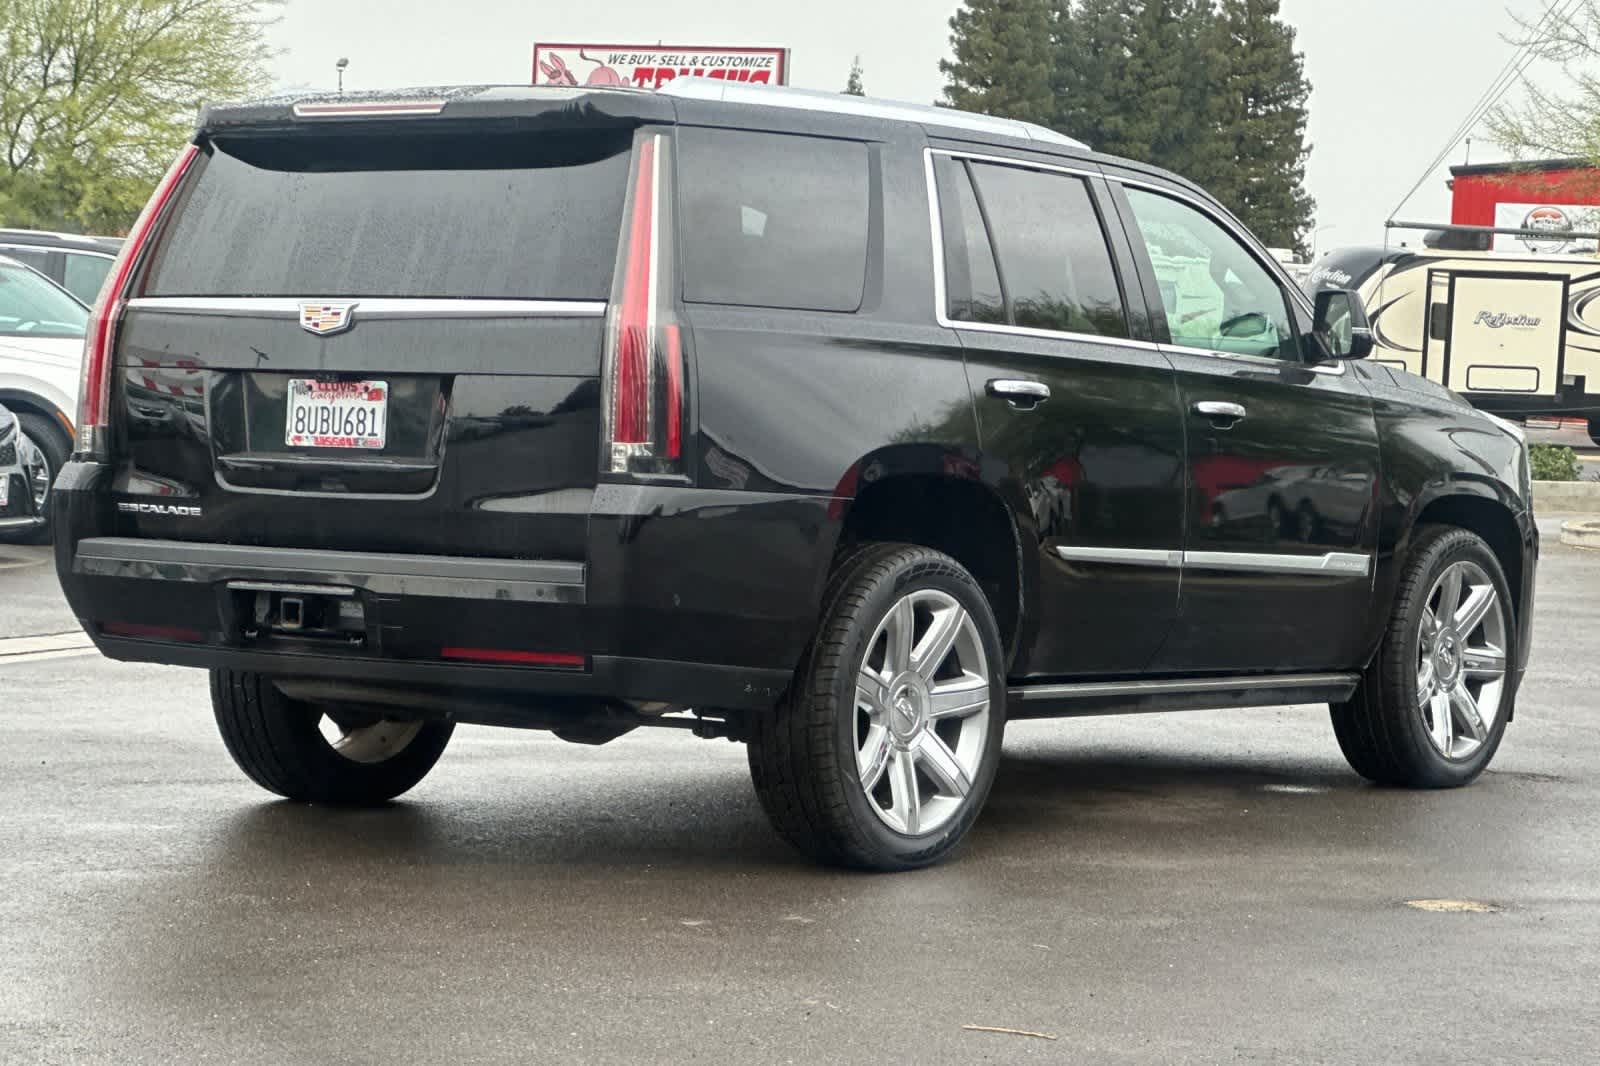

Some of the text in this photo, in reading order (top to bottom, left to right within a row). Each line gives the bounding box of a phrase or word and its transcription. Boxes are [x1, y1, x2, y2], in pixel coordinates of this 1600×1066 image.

[608, 53, 626, 65] WE
[658, 55, 686, 66] SELL
[689, 56, 699, 66] &
[701, 56, 774, 68] CUSTOMIZE
[1474, 310, 1541, 328] Reflection
[295, 406, 378, 437] 8UBU681
[117, 502, 202, 516] ESCALADE
